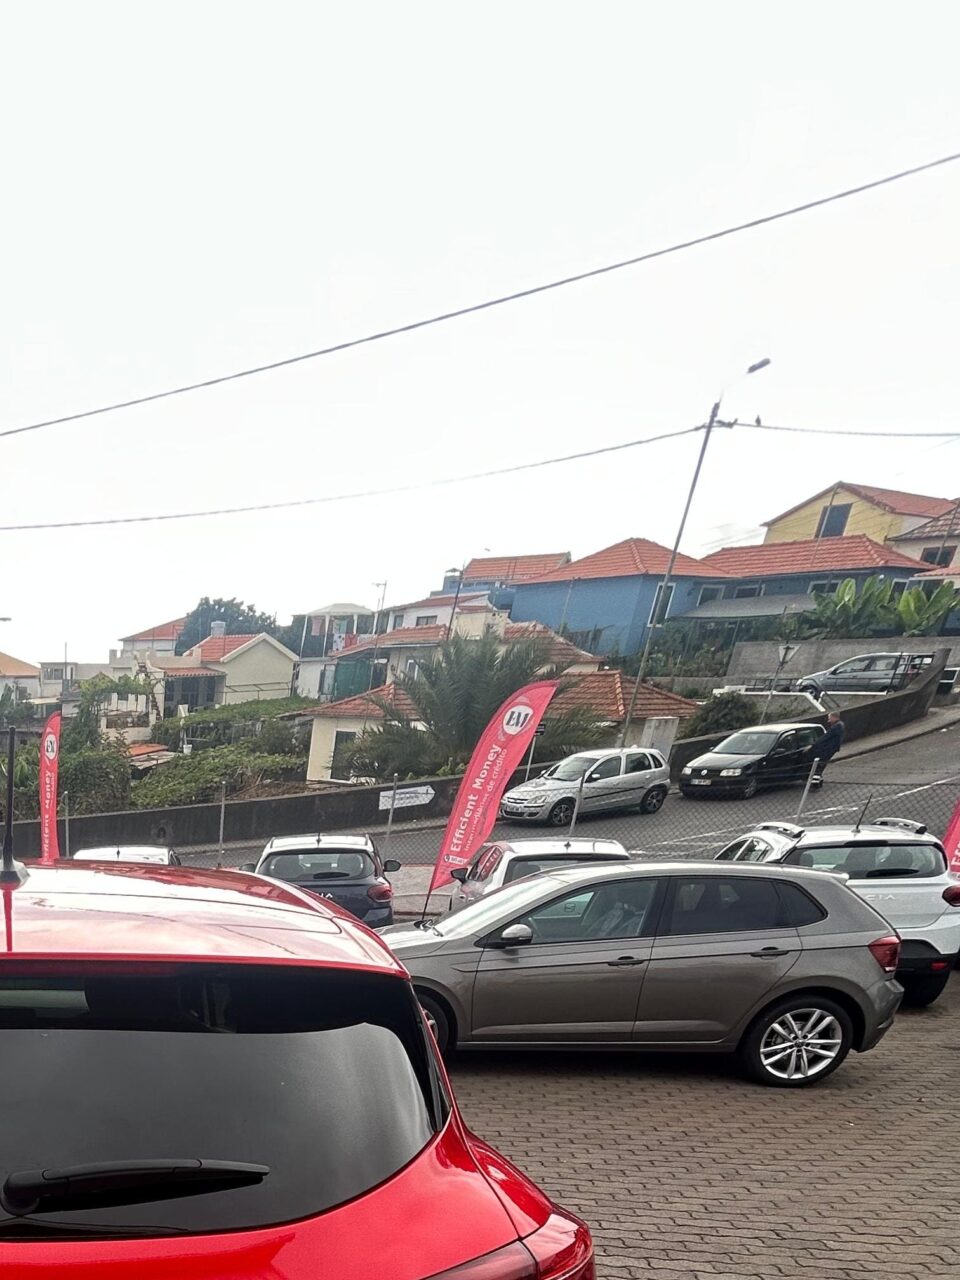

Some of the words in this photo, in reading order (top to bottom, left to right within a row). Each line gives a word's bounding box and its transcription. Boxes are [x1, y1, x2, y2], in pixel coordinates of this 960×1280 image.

[451, 793, 478, 852] Efficient
[472, 744, 501, 790] Money
[486, 780, 496, 792] de
